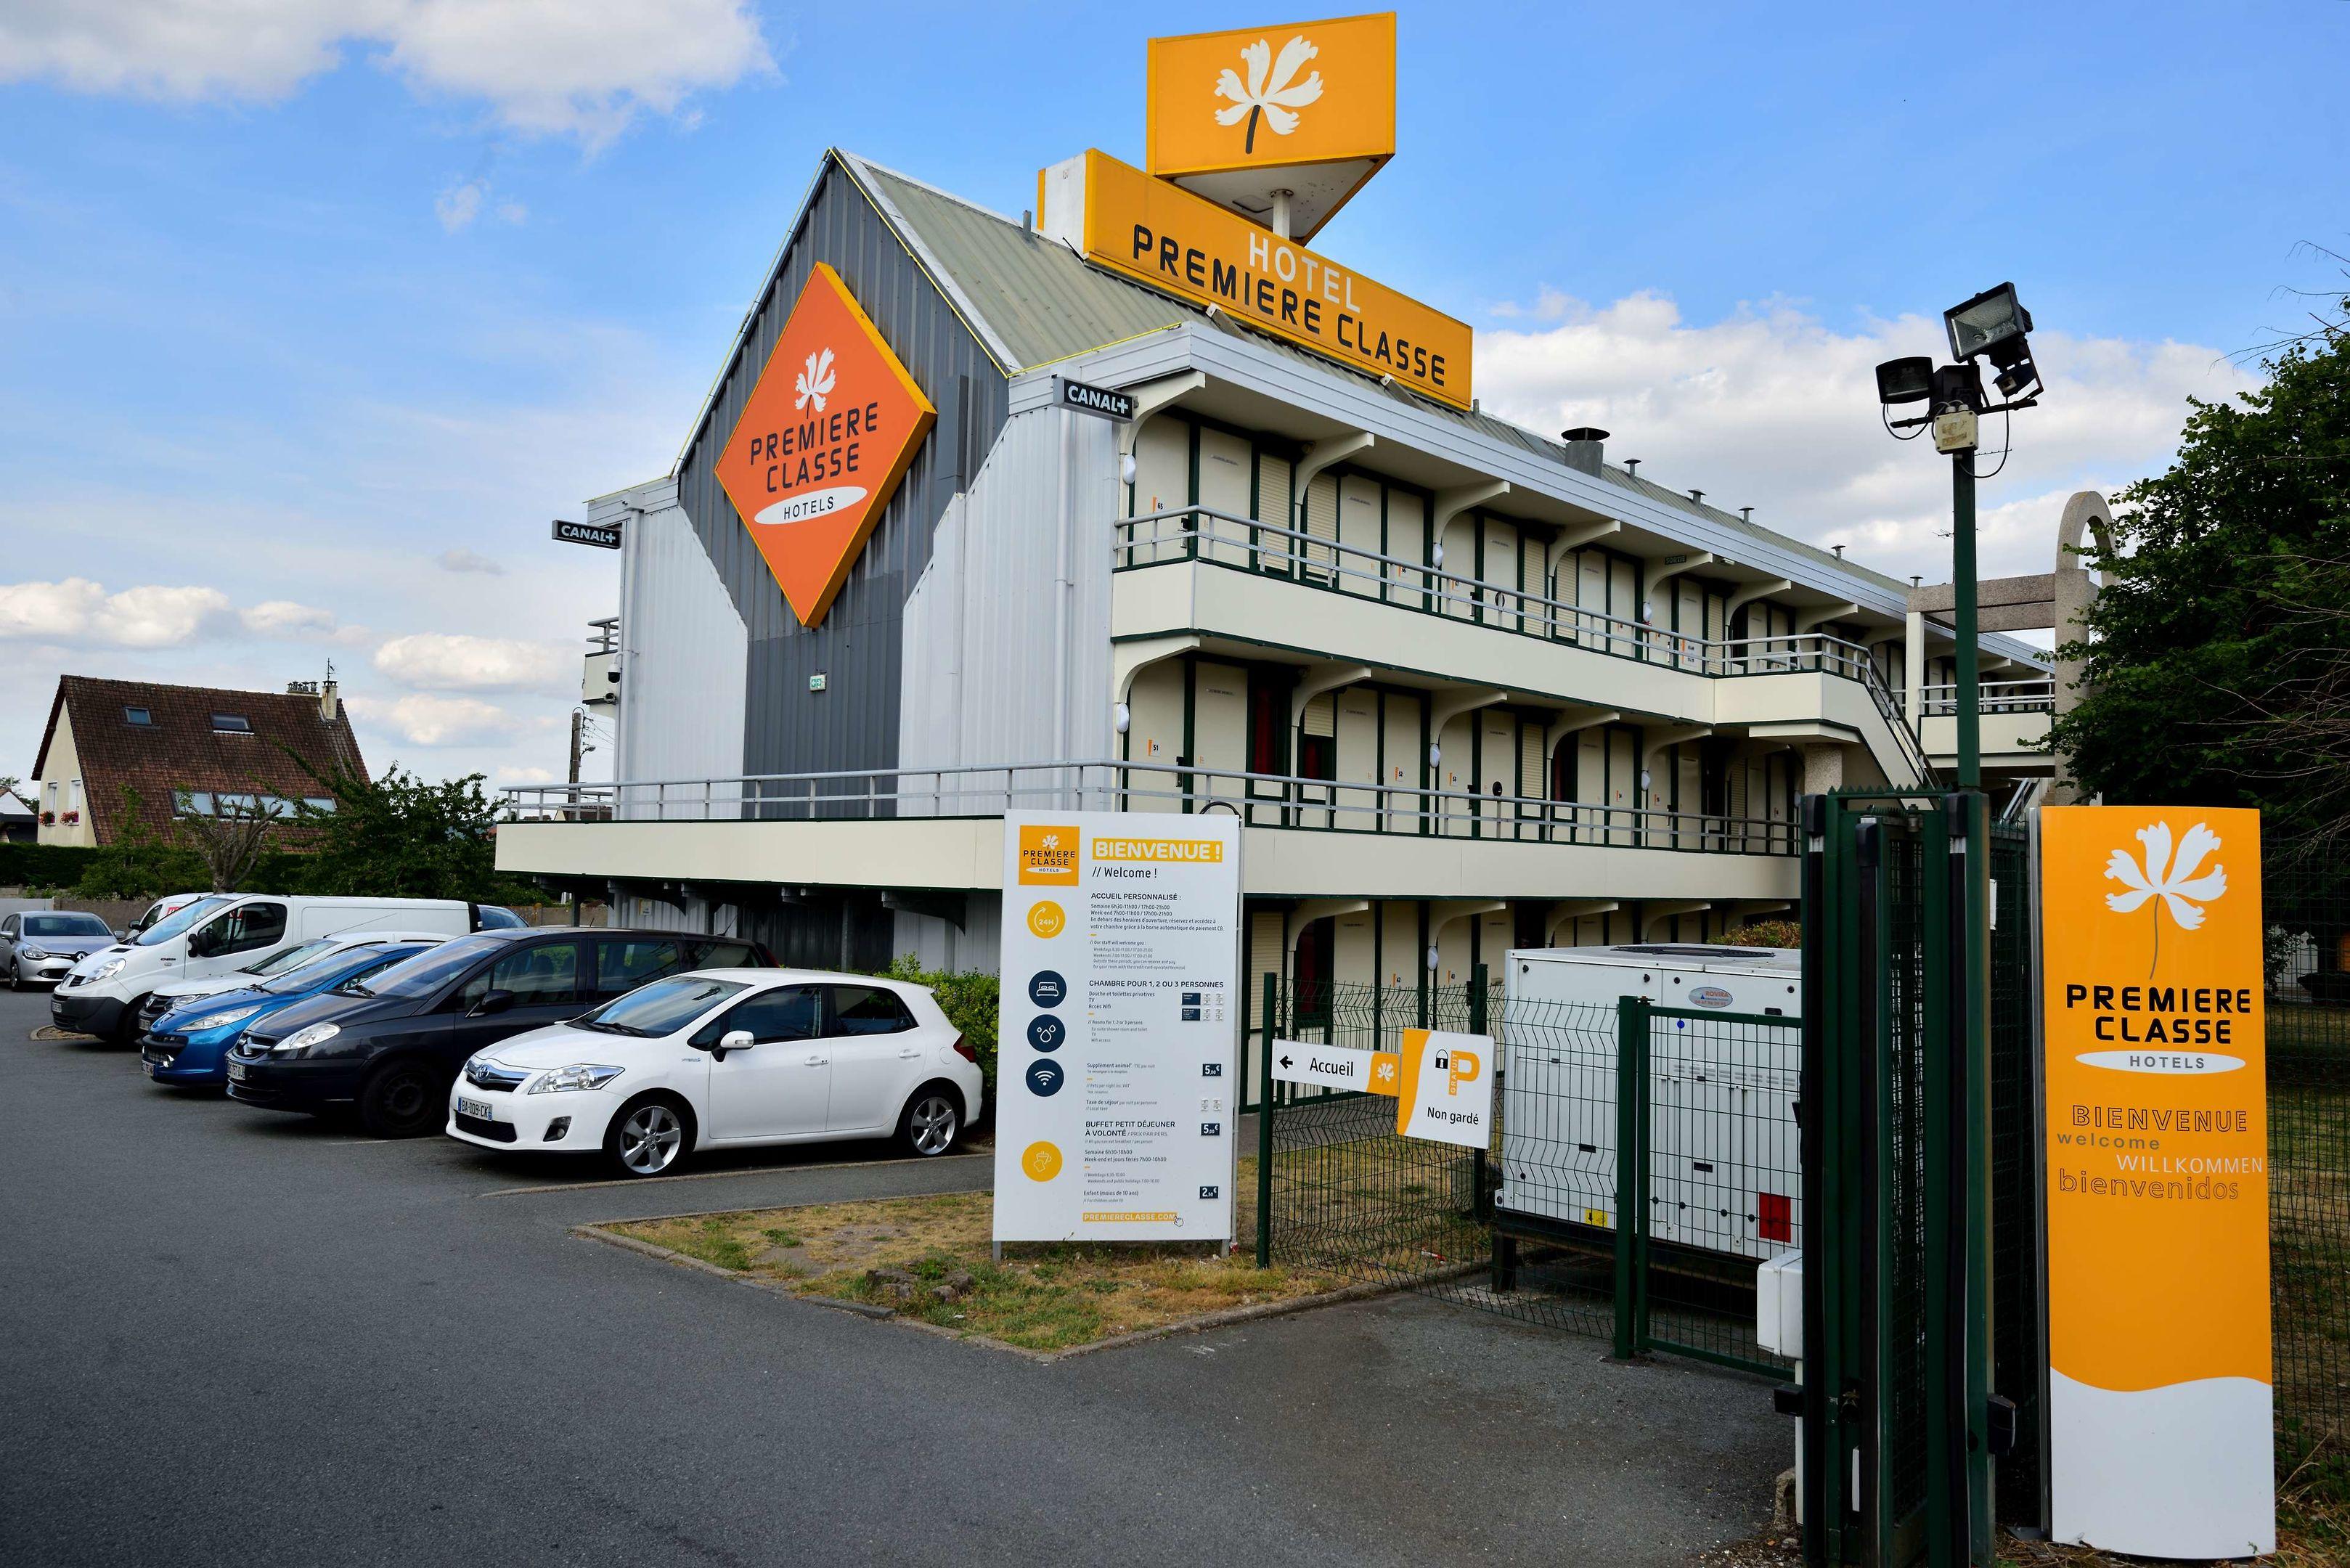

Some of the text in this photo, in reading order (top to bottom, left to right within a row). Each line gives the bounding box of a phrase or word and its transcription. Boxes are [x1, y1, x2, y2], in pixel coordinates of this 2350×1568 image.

[1249, 232, 1360, 314] HOTEL
[1133, 224, 1445, 388] PREMIERE CLASSE
[1068, 385, 1128, 414] CANAL+
[751, 402, 878, 465] PREMIERE
[767, 443, 859, 493] CLASSE
[784, 497, 834, 520] HOTELS
[561, 525, 616, 543] CANAL+
[1096, 841, 1220, 859] BIENVENUE !
[1104, 867, 1151, 878] Welcome
[2066, 984, 2251, 1013] PREMIERE
[2095, 1016, 2231, 1044] CLASSE
[1309, 1057, 1354, 1077] Accueil
[1448, 1050, 1480, 1095] P
[2130, 1055, 2204, 1069] HOTELS
[1427, 1106, 1479, 1125] Non gardé
[2073, 1105, 2247, 1132] BIENVENUE
[2057, 1132, 2160, 1151] welcome
[2116, 1154, 2263, 1175] WILLKOMMEN
[2059, 1168, 2239, 1200] bienvenidos
